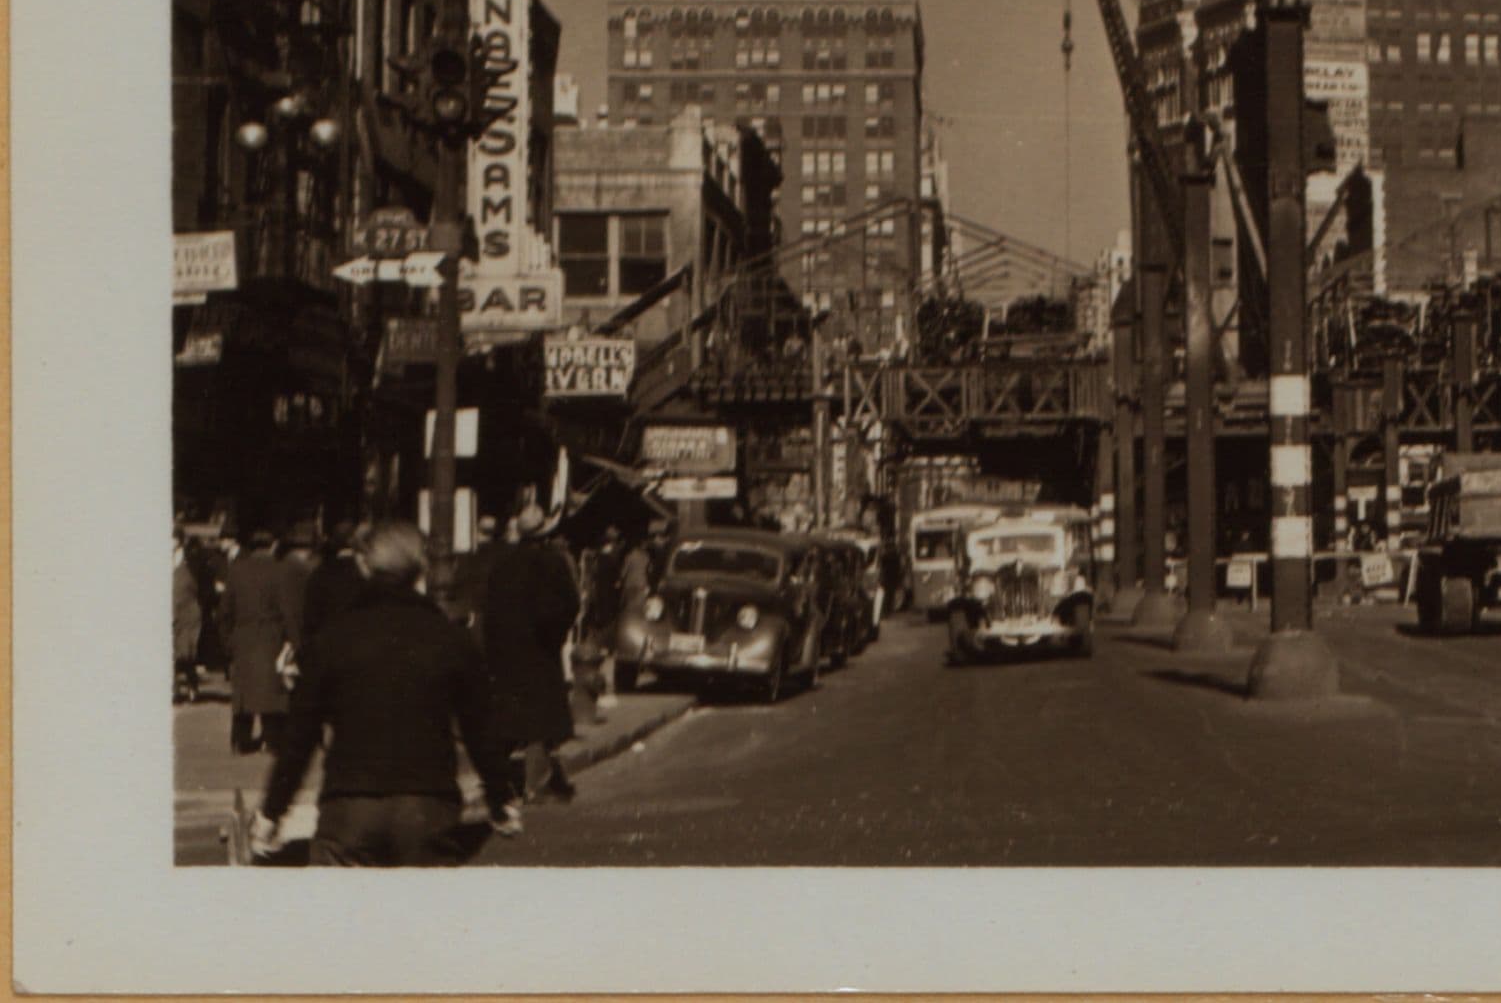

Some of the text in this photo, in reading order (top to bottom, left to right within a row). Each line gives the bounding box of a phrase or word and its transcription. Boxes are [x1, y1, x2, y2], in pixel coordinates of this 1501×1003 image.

[480, 131, 515, 258] SAMS
[375, 227, 401, 251] 27
[405, 228, 428, 251] ST
[458, 287, 547, 313] BAR
